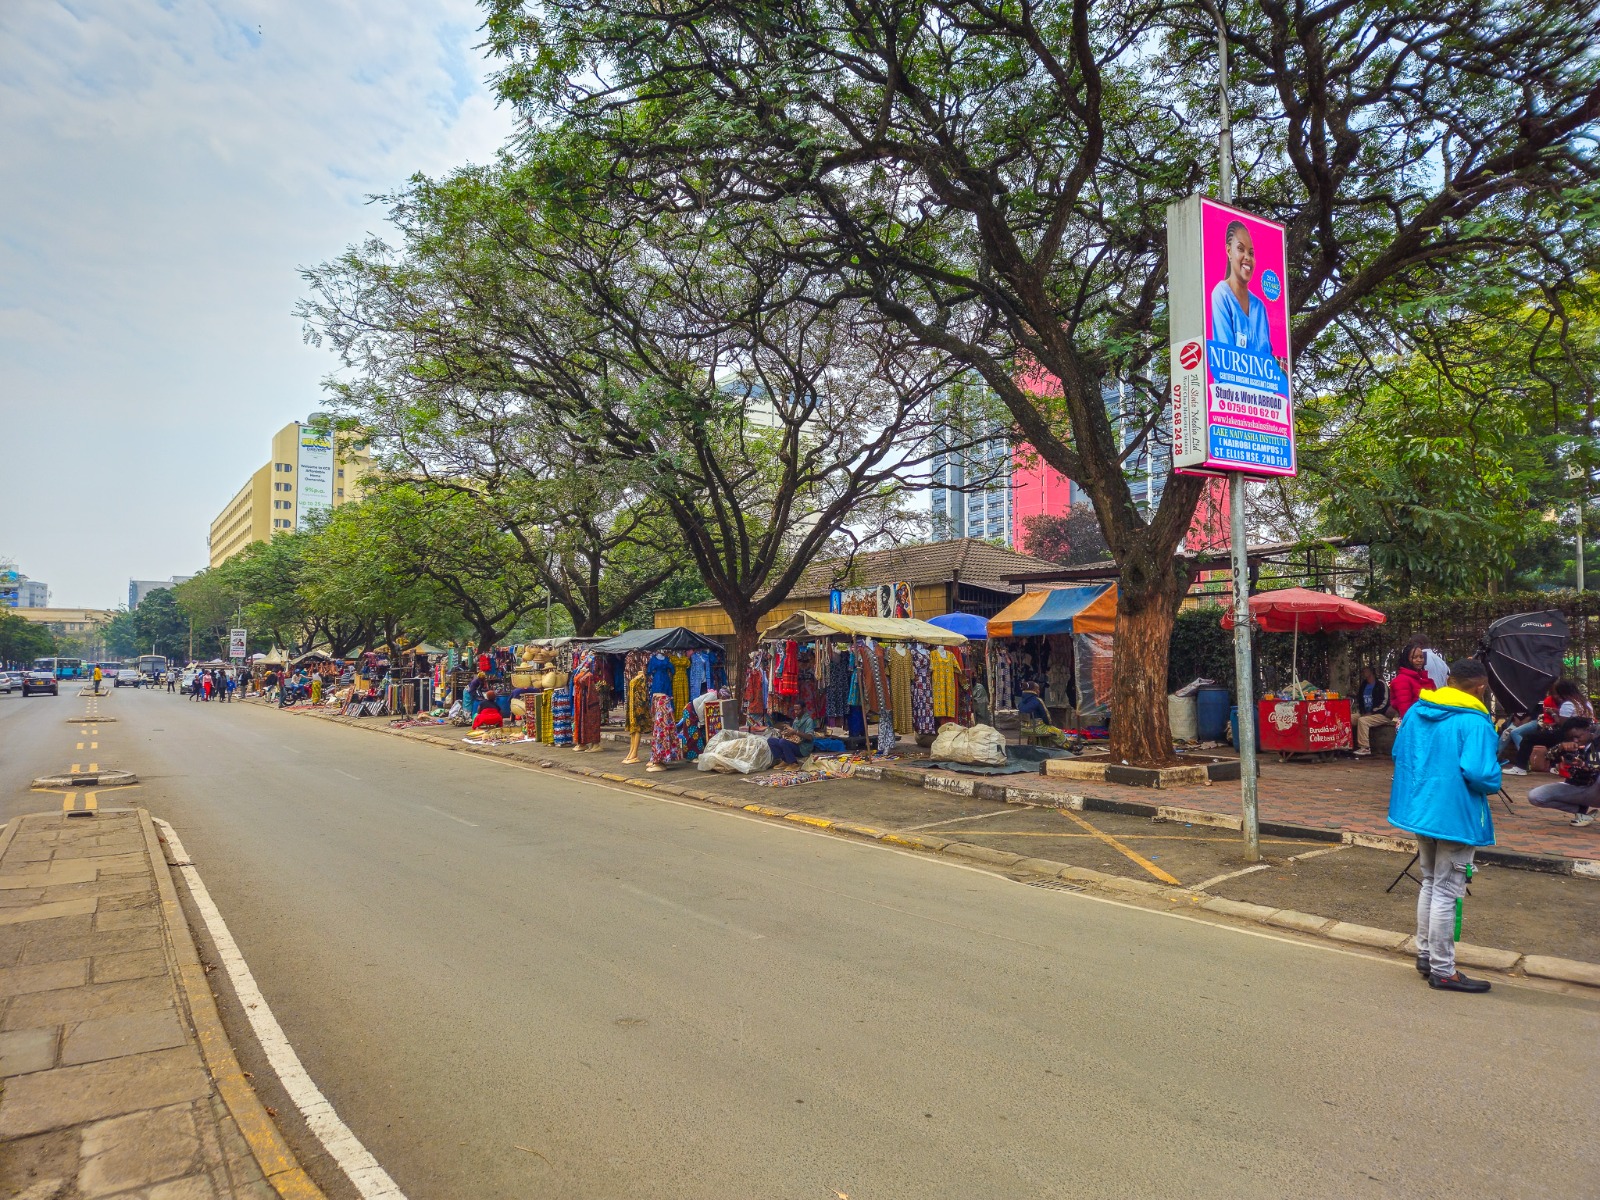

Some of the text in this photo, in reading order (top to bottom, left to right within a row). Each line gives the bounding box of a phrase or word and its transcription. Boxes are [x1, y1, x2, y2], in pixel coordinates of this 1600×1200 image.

[1190, 374, 1200, 387] All
[1215, 386, 1282, 410] Study & Work ABROAD
[1173, 384, 1183, 456] 0772 68 24 28
[1227, 401, 1280, 420] 0759 00 62 07
[1191, 409, 1201, 436] Media
[1192, 436, 1202, 452] Ltd
[1212, 426, 1289, 447] LAKE NAIVASHA INSTITUTE
[1223, 438, 1251, 450] NAIROBI
[1251, 442, 1280, 455] CAMPUS
[1214, 446, 1225, 458] ST.
[1226, 448, 1245, 460] ELLIS
[1261, 453, 1276, 465] 2ND
[1276, 455, 1288, 467] FLR
